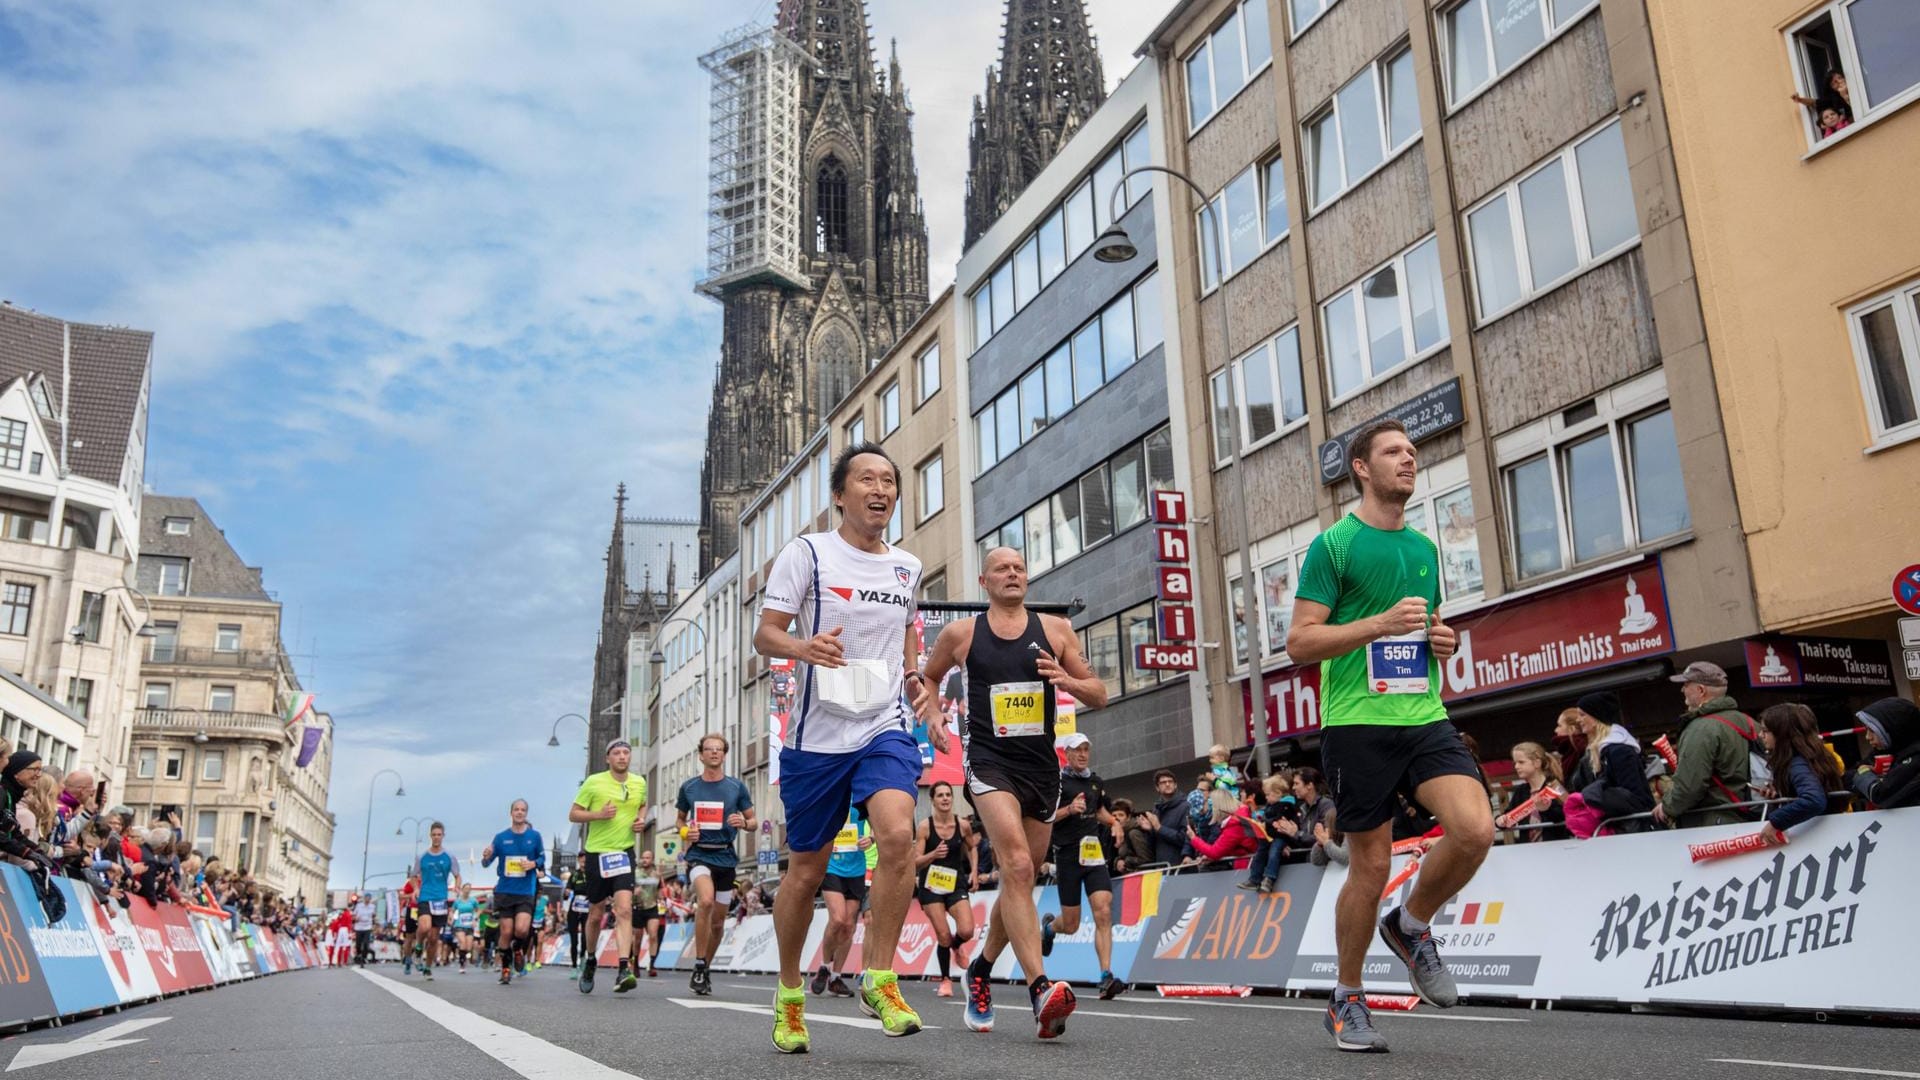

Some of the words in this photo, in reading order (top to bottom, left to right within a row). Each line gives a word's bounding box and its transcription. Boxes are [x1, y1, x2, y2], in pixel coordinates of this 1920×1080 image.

[1428, 382, 1456, 400] Markisen
[1420, 408, 1432, 421] 22
[1433, 402, 1445, 415] 20
[1407, 412, 1454, 441] technik.de
[1157, 492, 1188, 636] Thai
[1383, 645, 1418, 660] 5567
[1620, 638, 1640, 654] Thai
[1640, 634, 1662, 650] Food
[1798, 642, 1823, 658] Thai
[1824, 643, 1852, 659] Food
[1144, 648, 1194, 666] Food
[1475, 653, 1509, 687] Thai
[1510, 642, 1559, 680] Famili
[1559, 632, 1614, 668] Imbiss
[1395, 666, 1412, 675] Tim
[1843, 659, 1888, 678] Takeaway
[1759, 675, 1775, 683] Thai
[1775, 675, 1792, 683] Food
[1804, 673, 1816, 683] Alle
[1816, 673, 1838, 684] Gerichte
[1839, 675, 1850, 684] auch
[1850, 677, 1862, 685] zum
[1004, 696, 1034, 709] 7440
[1269, 677, 1318, 732] Th
[1590, 820, 1883, 962] Reissdorf
[1191, 891, 1291, 960] AWB
[1644, 903, 1859, 989] ALKOHOLFREI
